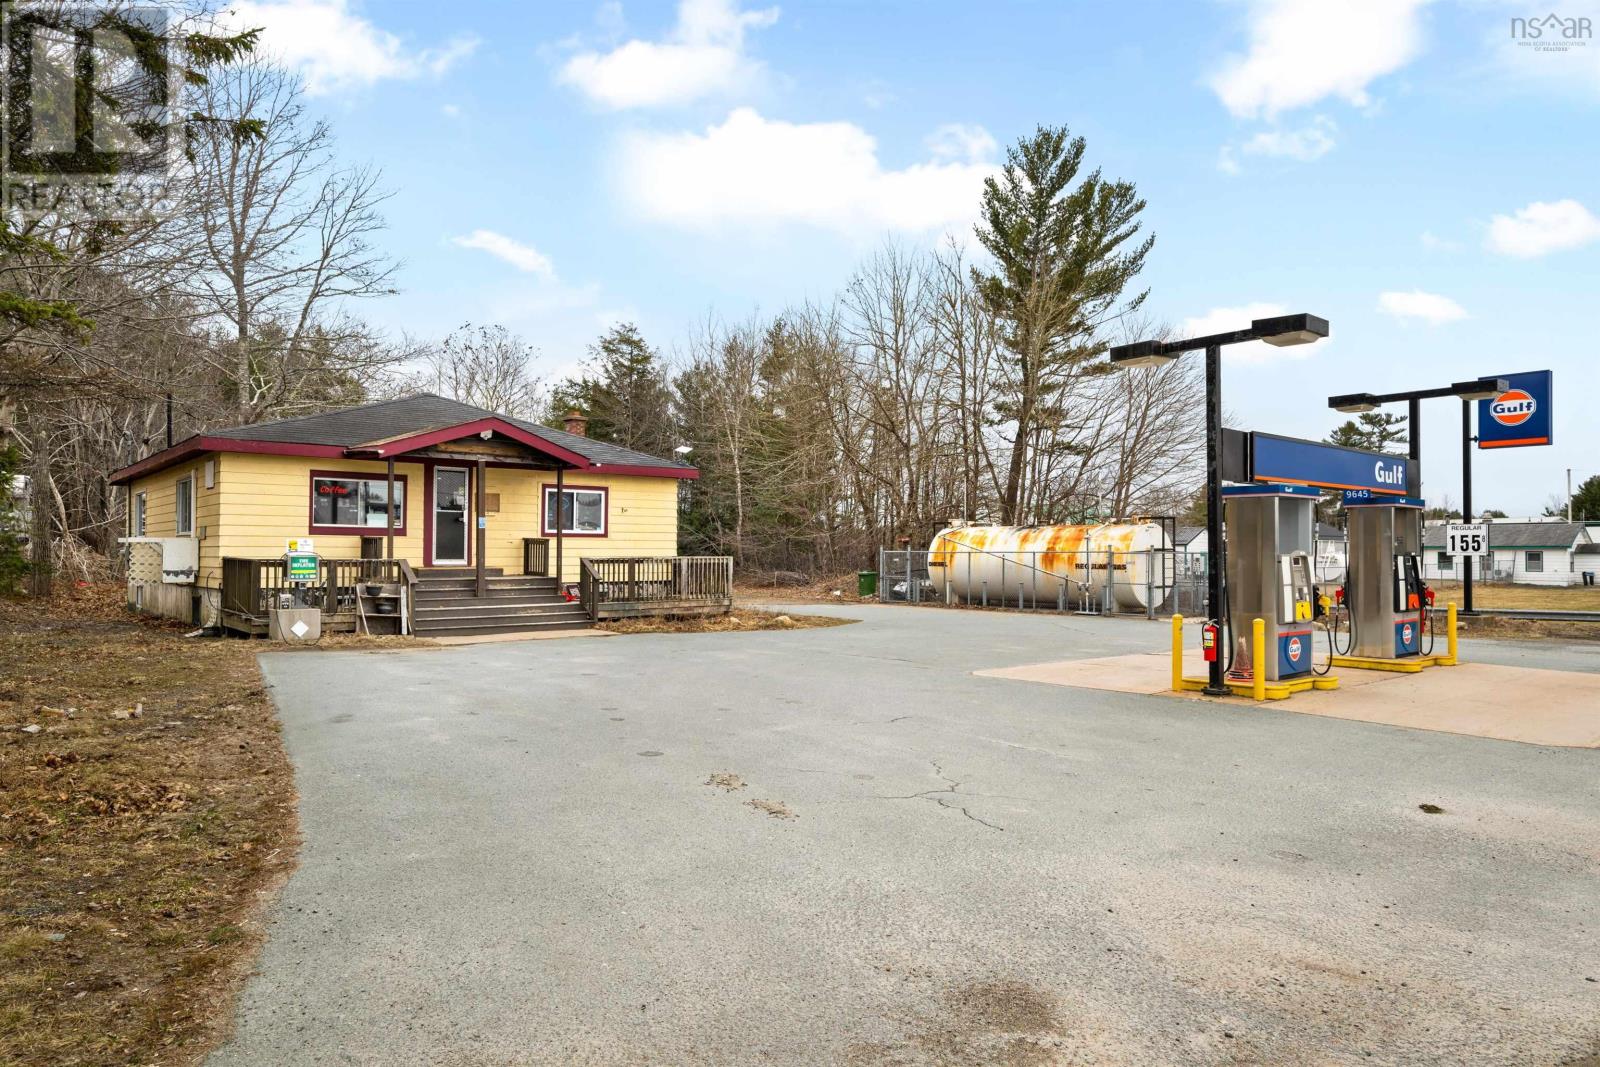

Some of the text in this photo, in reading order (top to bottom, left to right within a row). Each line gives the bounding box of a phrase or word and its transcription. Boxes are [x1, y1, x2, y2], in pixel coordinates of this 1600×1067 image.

[1493, 402, 1533, 414] Gulf
[1375, 461, 1403, 485] Gulf
[320, 486, 348, 495] Coffee
[1346, 490, 1368, 498] 9645
[1450, 535, 1481, 552] 155
